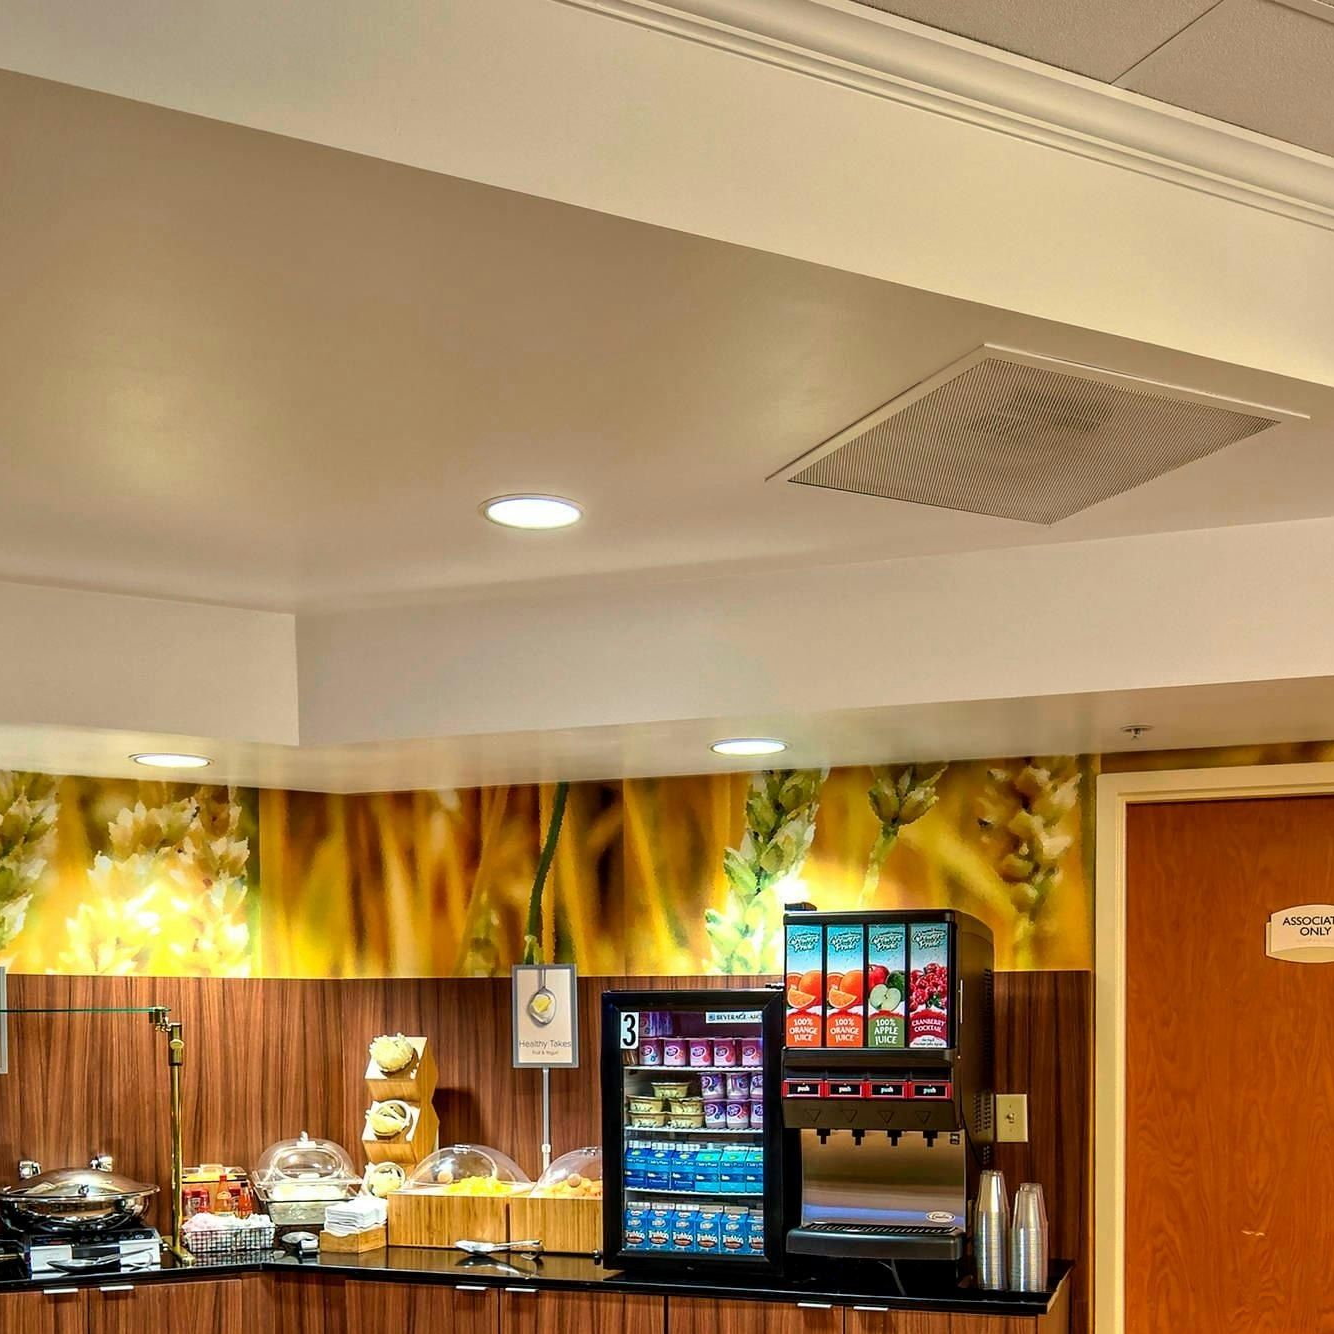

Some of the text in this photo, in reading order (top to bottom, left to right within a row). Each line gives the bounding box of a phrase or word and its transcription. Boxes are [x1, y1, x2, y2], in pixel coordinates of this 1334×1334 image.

[1299, 926, 1332, 936] ONLY
[794, 1018, 813, 1026] 100%
[835, 1018, 855, 1026] 100%
[875, 1018, 896, 1027] 100%
[911, 1018, 946, 1027] CRANBERRY
[622, 1014, 636, 1046] 3
[789, 1026, 818, 1035] ORANGE
[830, 1026, 859, 1035] ORANGE
[874, 1026, 899, 1035] APPLE
[914, 1025, 942, 1033] COCKTAIL
[794, 1034, 812, 1043] JUICE
[835, 1034, 854, 1043] JUICE
[875, 1035, 897, 1045] JUICE
[519, 1040, 572, 1049] Healthy Takes
